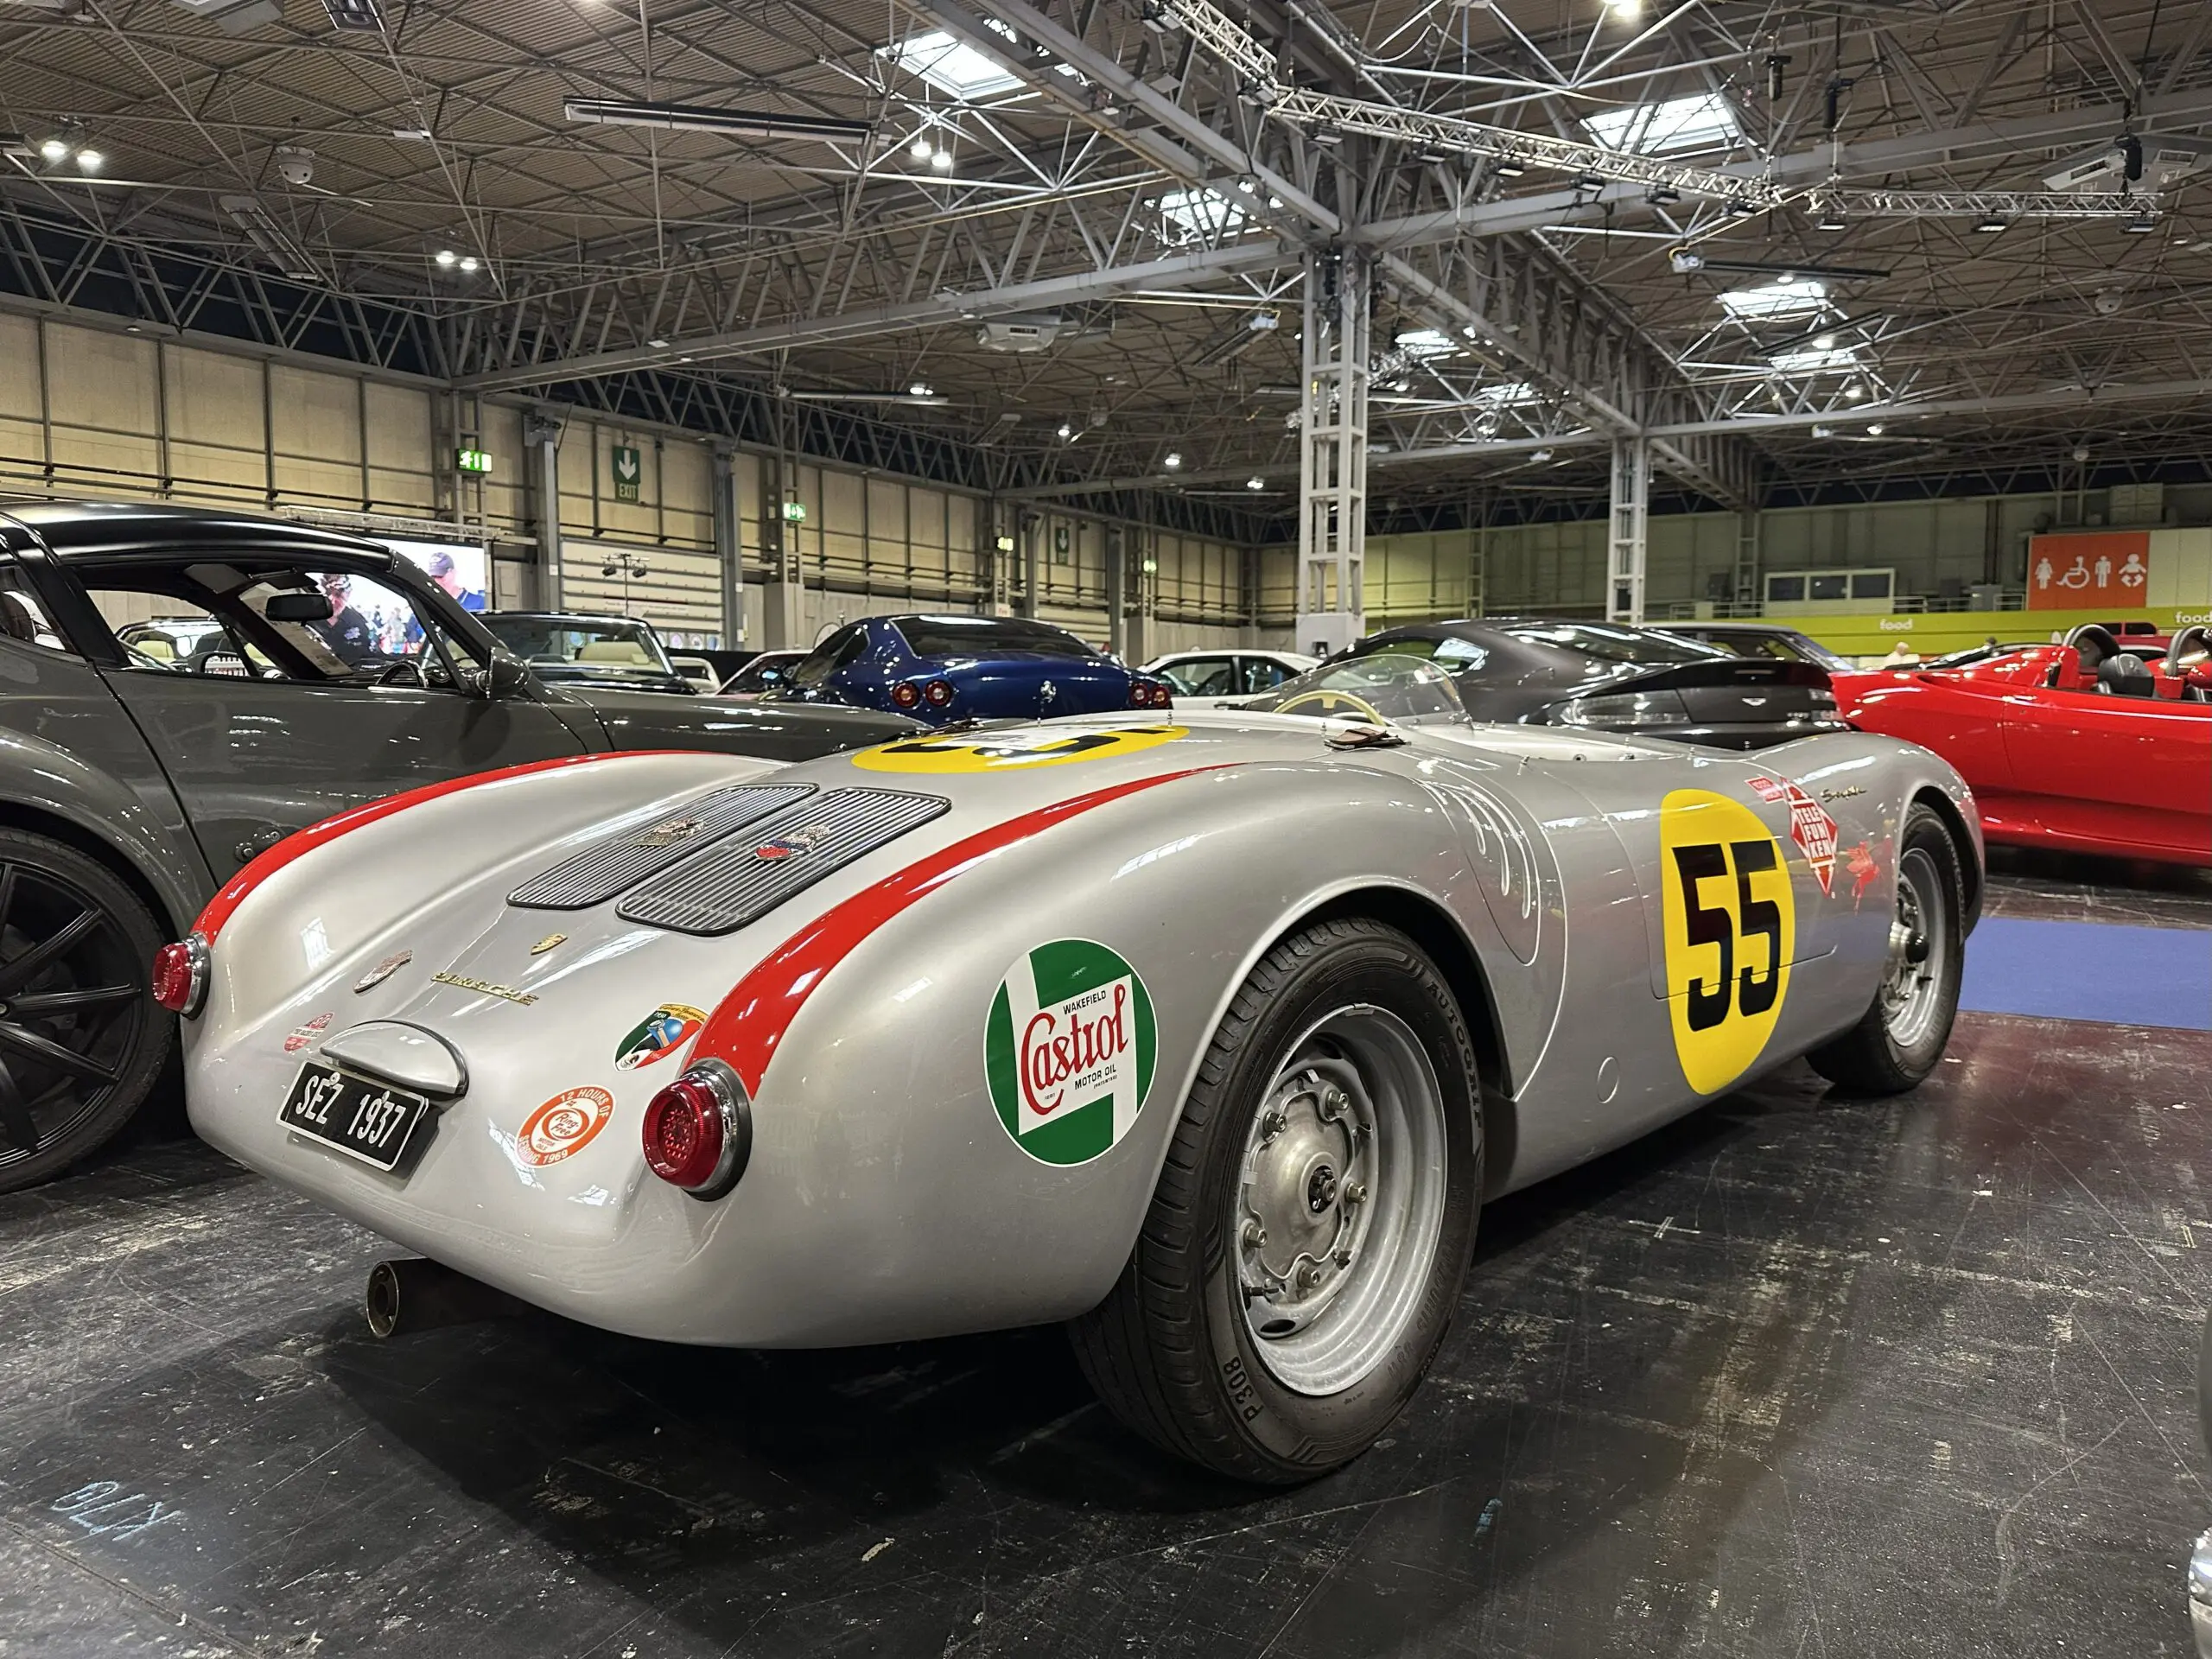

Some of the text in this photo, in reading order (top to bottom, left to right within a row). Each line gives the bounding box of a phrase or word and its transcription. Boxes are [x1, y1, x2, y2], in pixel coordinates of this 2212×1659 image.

[620, 484, 637, 499] EXIT
[1880, 618, 1913, 631] food
[2175, 610, 2212, 624] food
[1796, 805, 1821, 824] TELE
[1803, 823, 1827, 842] FUN
[1809, 840, 1833, 859] KEN
[1671, 839, 1781, 1033] 55
[1063, 990, 1107, 1014] WAKEFIELD
[1021, 983, 1128, 1116] Castrol
[1426, 981, 1483, 1128] AUTOGRIP
[1074, 1064, 1117, 1090] MOTOR OIL
[296, 1075, 406, 1147] SEZ 1937
[559, 1091, 575, 1102] 12
[577, 1088, 609, 1106] HOURS
[598, 1105, 611, 1118] OF
[550, 1122, 571, 1135] Free
[518, 1134, 569, 1165] SEBRING 1969
[1223, 1356, 1265, 1422] P308
